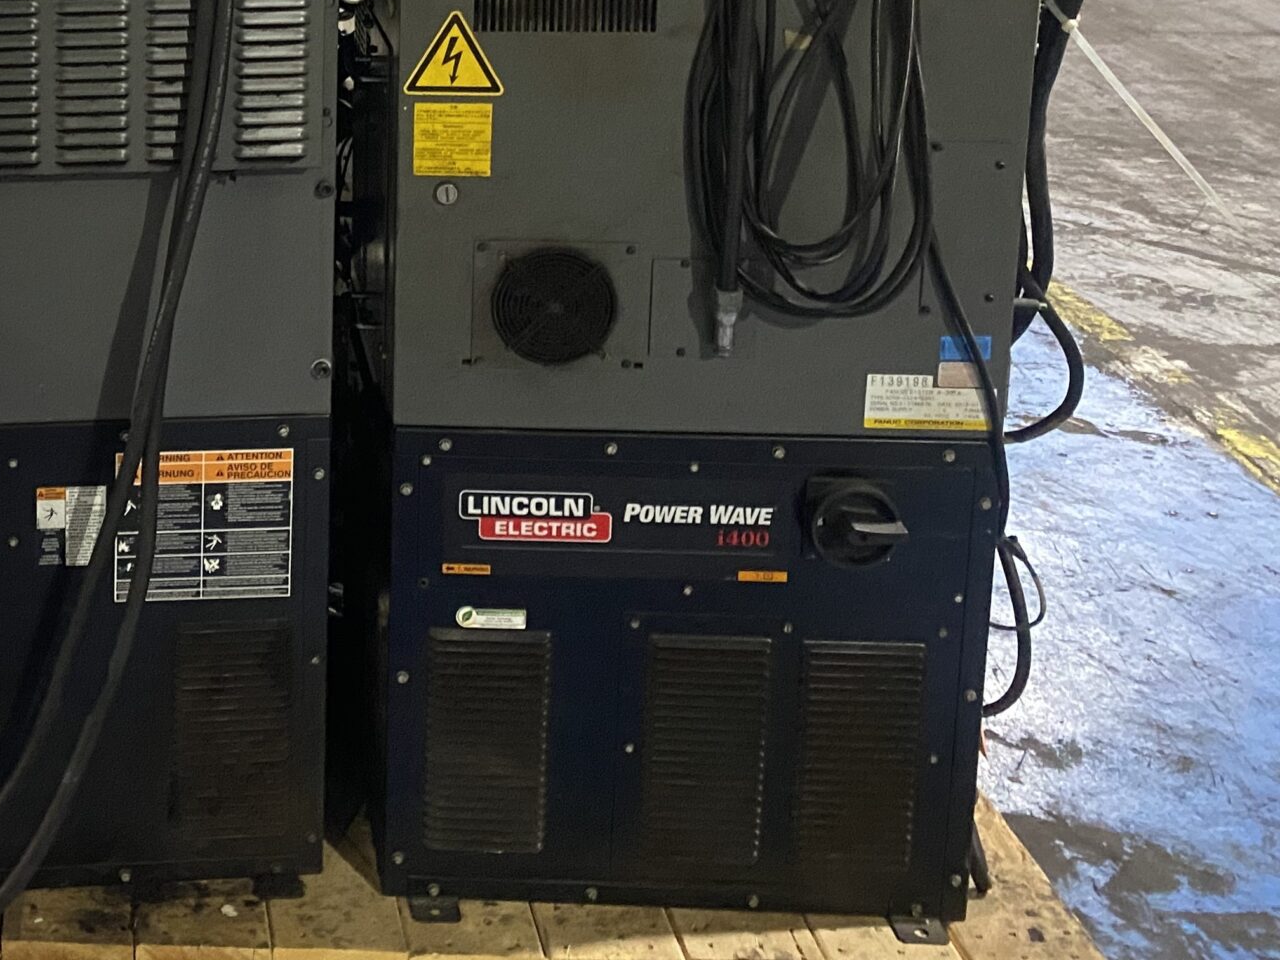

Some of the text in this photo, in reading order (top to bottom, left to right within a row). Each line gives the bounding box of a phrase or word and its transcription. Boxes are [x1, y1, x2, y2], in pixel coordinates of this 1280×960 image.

[160, 454, 191, 463] RNING
[226, 451, 283, 461] ATTENTION
[226, 462, 273, 472] AVISO DE
[159, 469, 195, 478] RNUNG
[226, 470, 291, 480] PRECAUCION
[467, 495, 585, 517] LINCOLN
[623, 502, 774, 526] POWER WAVE
[494, 520, 598, 538] ELECTRIC
[715, 529, 770, 547] i400
